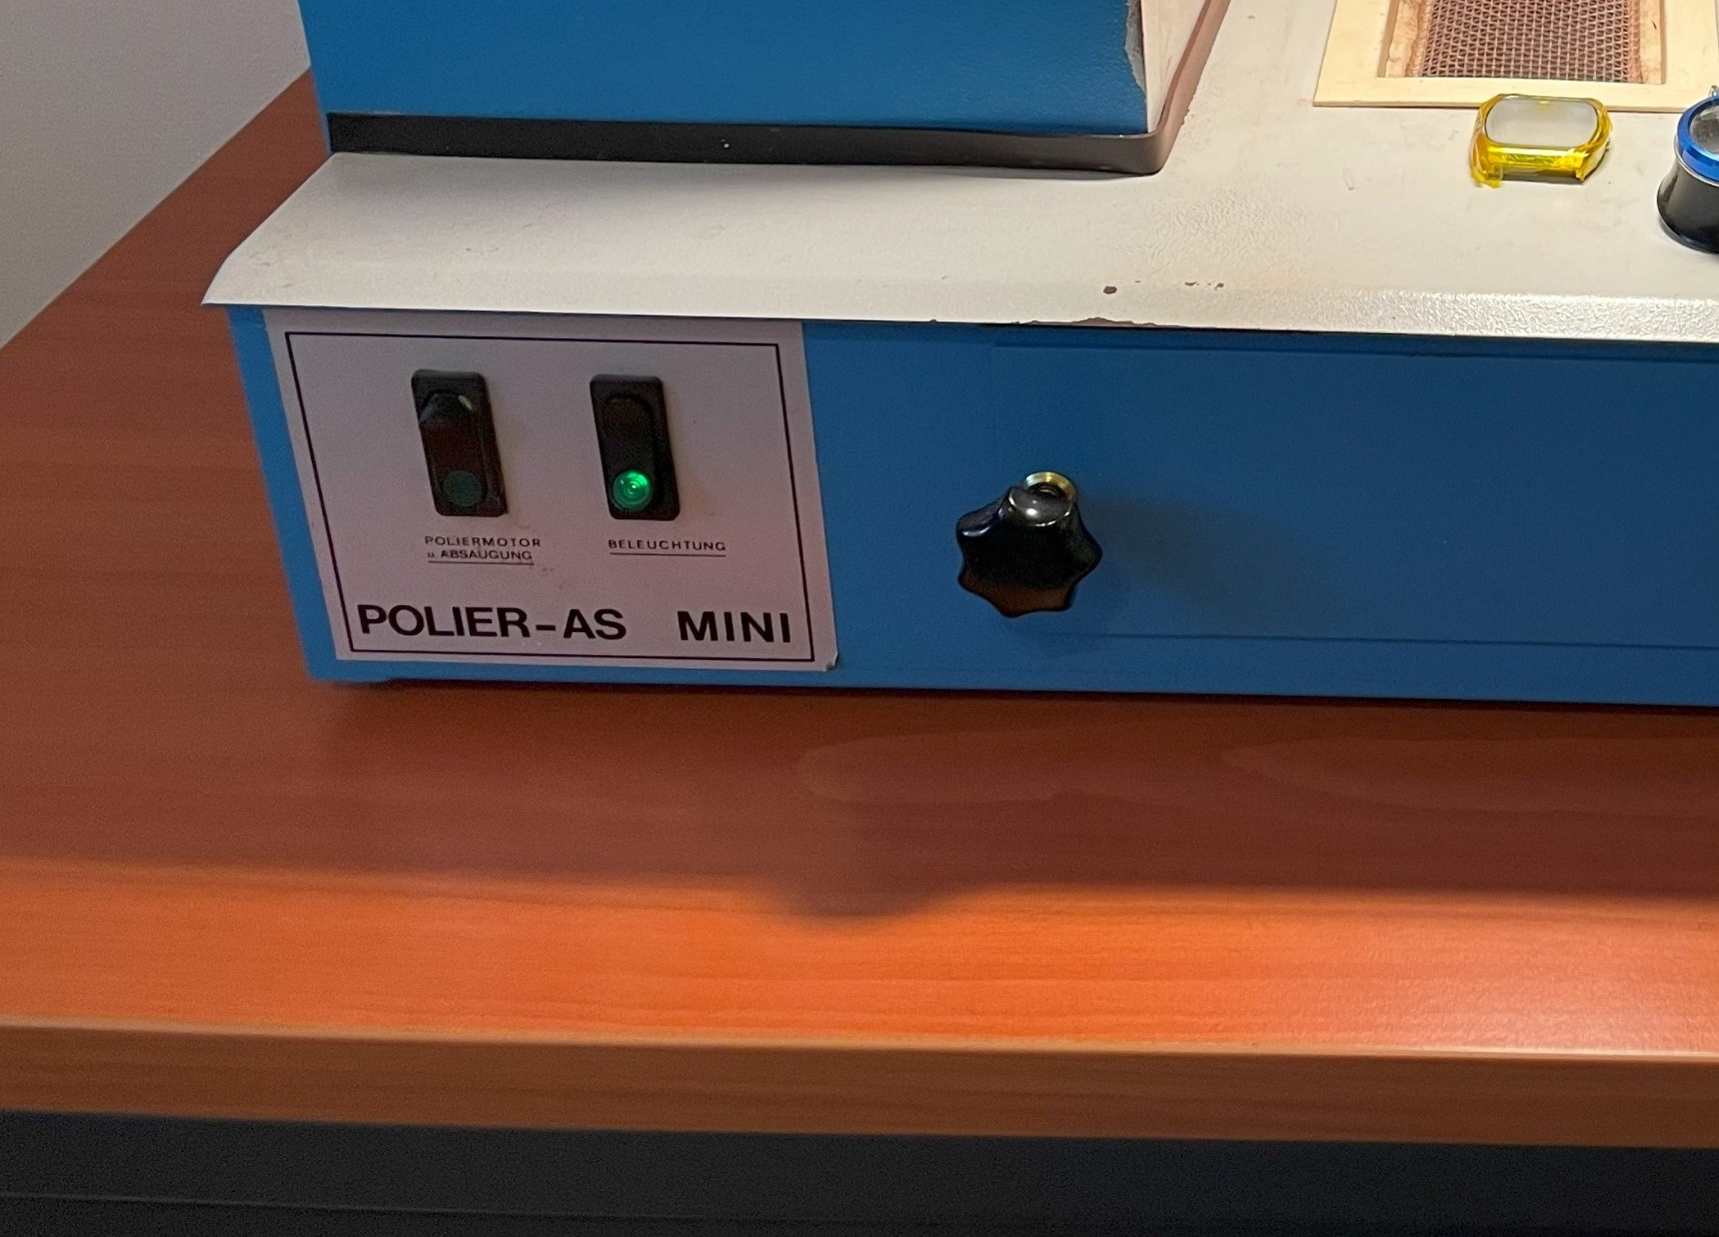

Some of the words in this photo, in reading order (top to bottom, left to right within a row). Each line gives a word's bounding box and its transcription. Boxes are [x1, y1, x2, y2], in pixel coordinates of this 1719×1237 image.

[424, 535, 541, 548] POLIERMOTOR
[608, 538, 727, 552] BELEUCHTUNG
[440, 549, 533, 561] ABSAUGUNG
[356, 604, 628, 642] POLIER-AS
[677, 611, 792, 644] MINI
